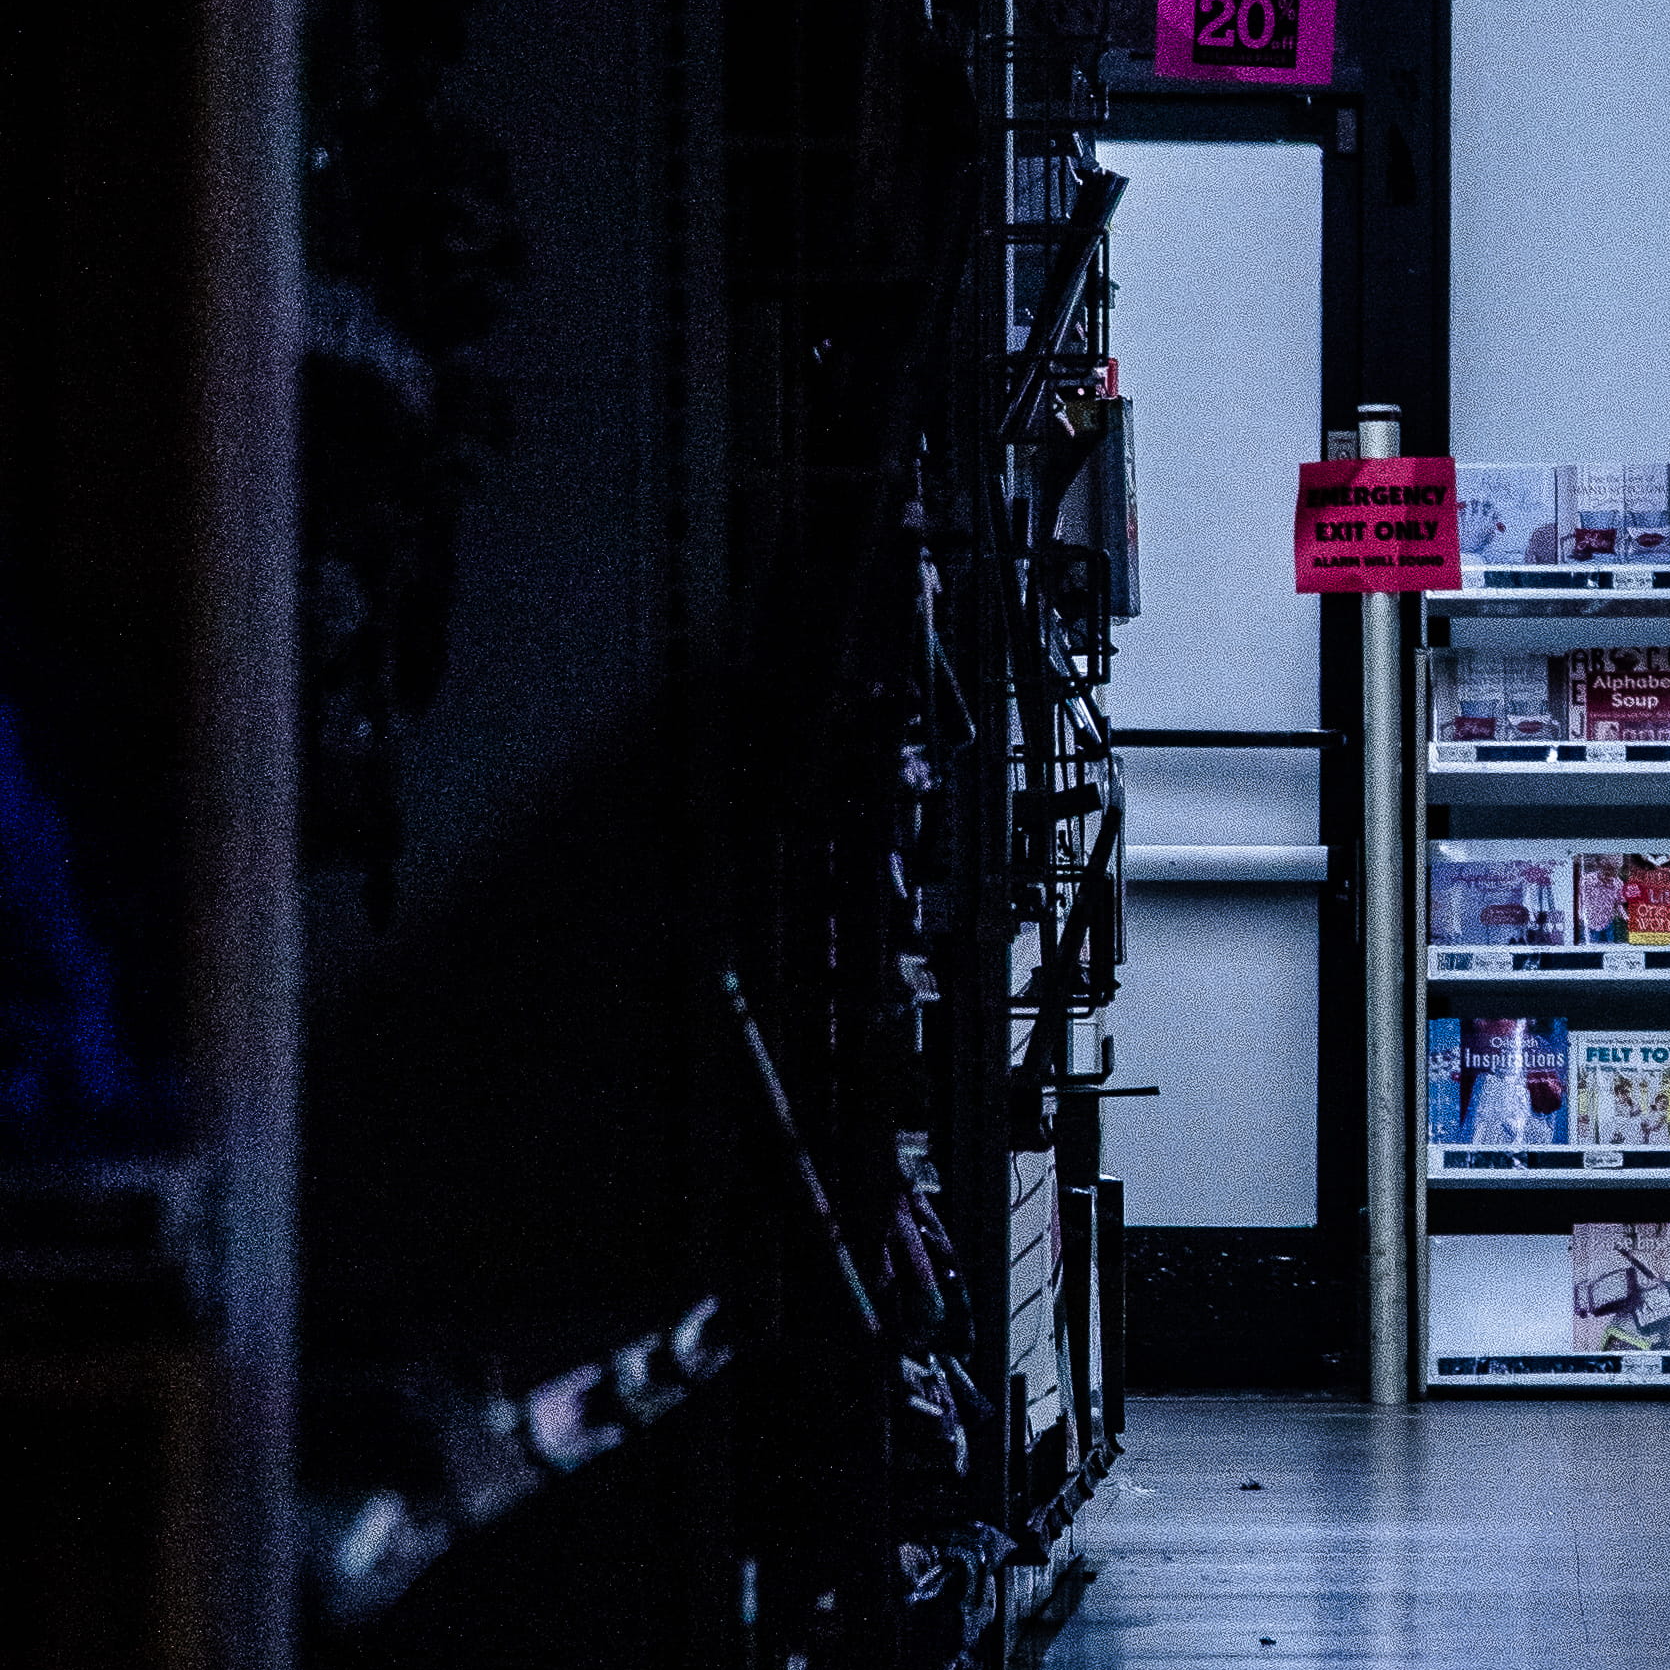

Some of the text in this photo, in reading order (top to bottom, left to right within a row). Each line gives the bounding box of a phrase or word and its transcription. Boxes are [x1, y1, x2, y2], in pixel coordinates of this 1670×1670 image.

[1271, 35, 1296, 51] off
[1307, 485, 1447, 507] EMERGENCY
[1316, 520, 1438, 541] EXIT ONLY
[1314, 556, 1361, 567] ALARM
[1364, 556, 1394, 566] WILL
[1611, 693, 1660, 710] Soup
[1586, 1047, 1633, 1063] FELT
